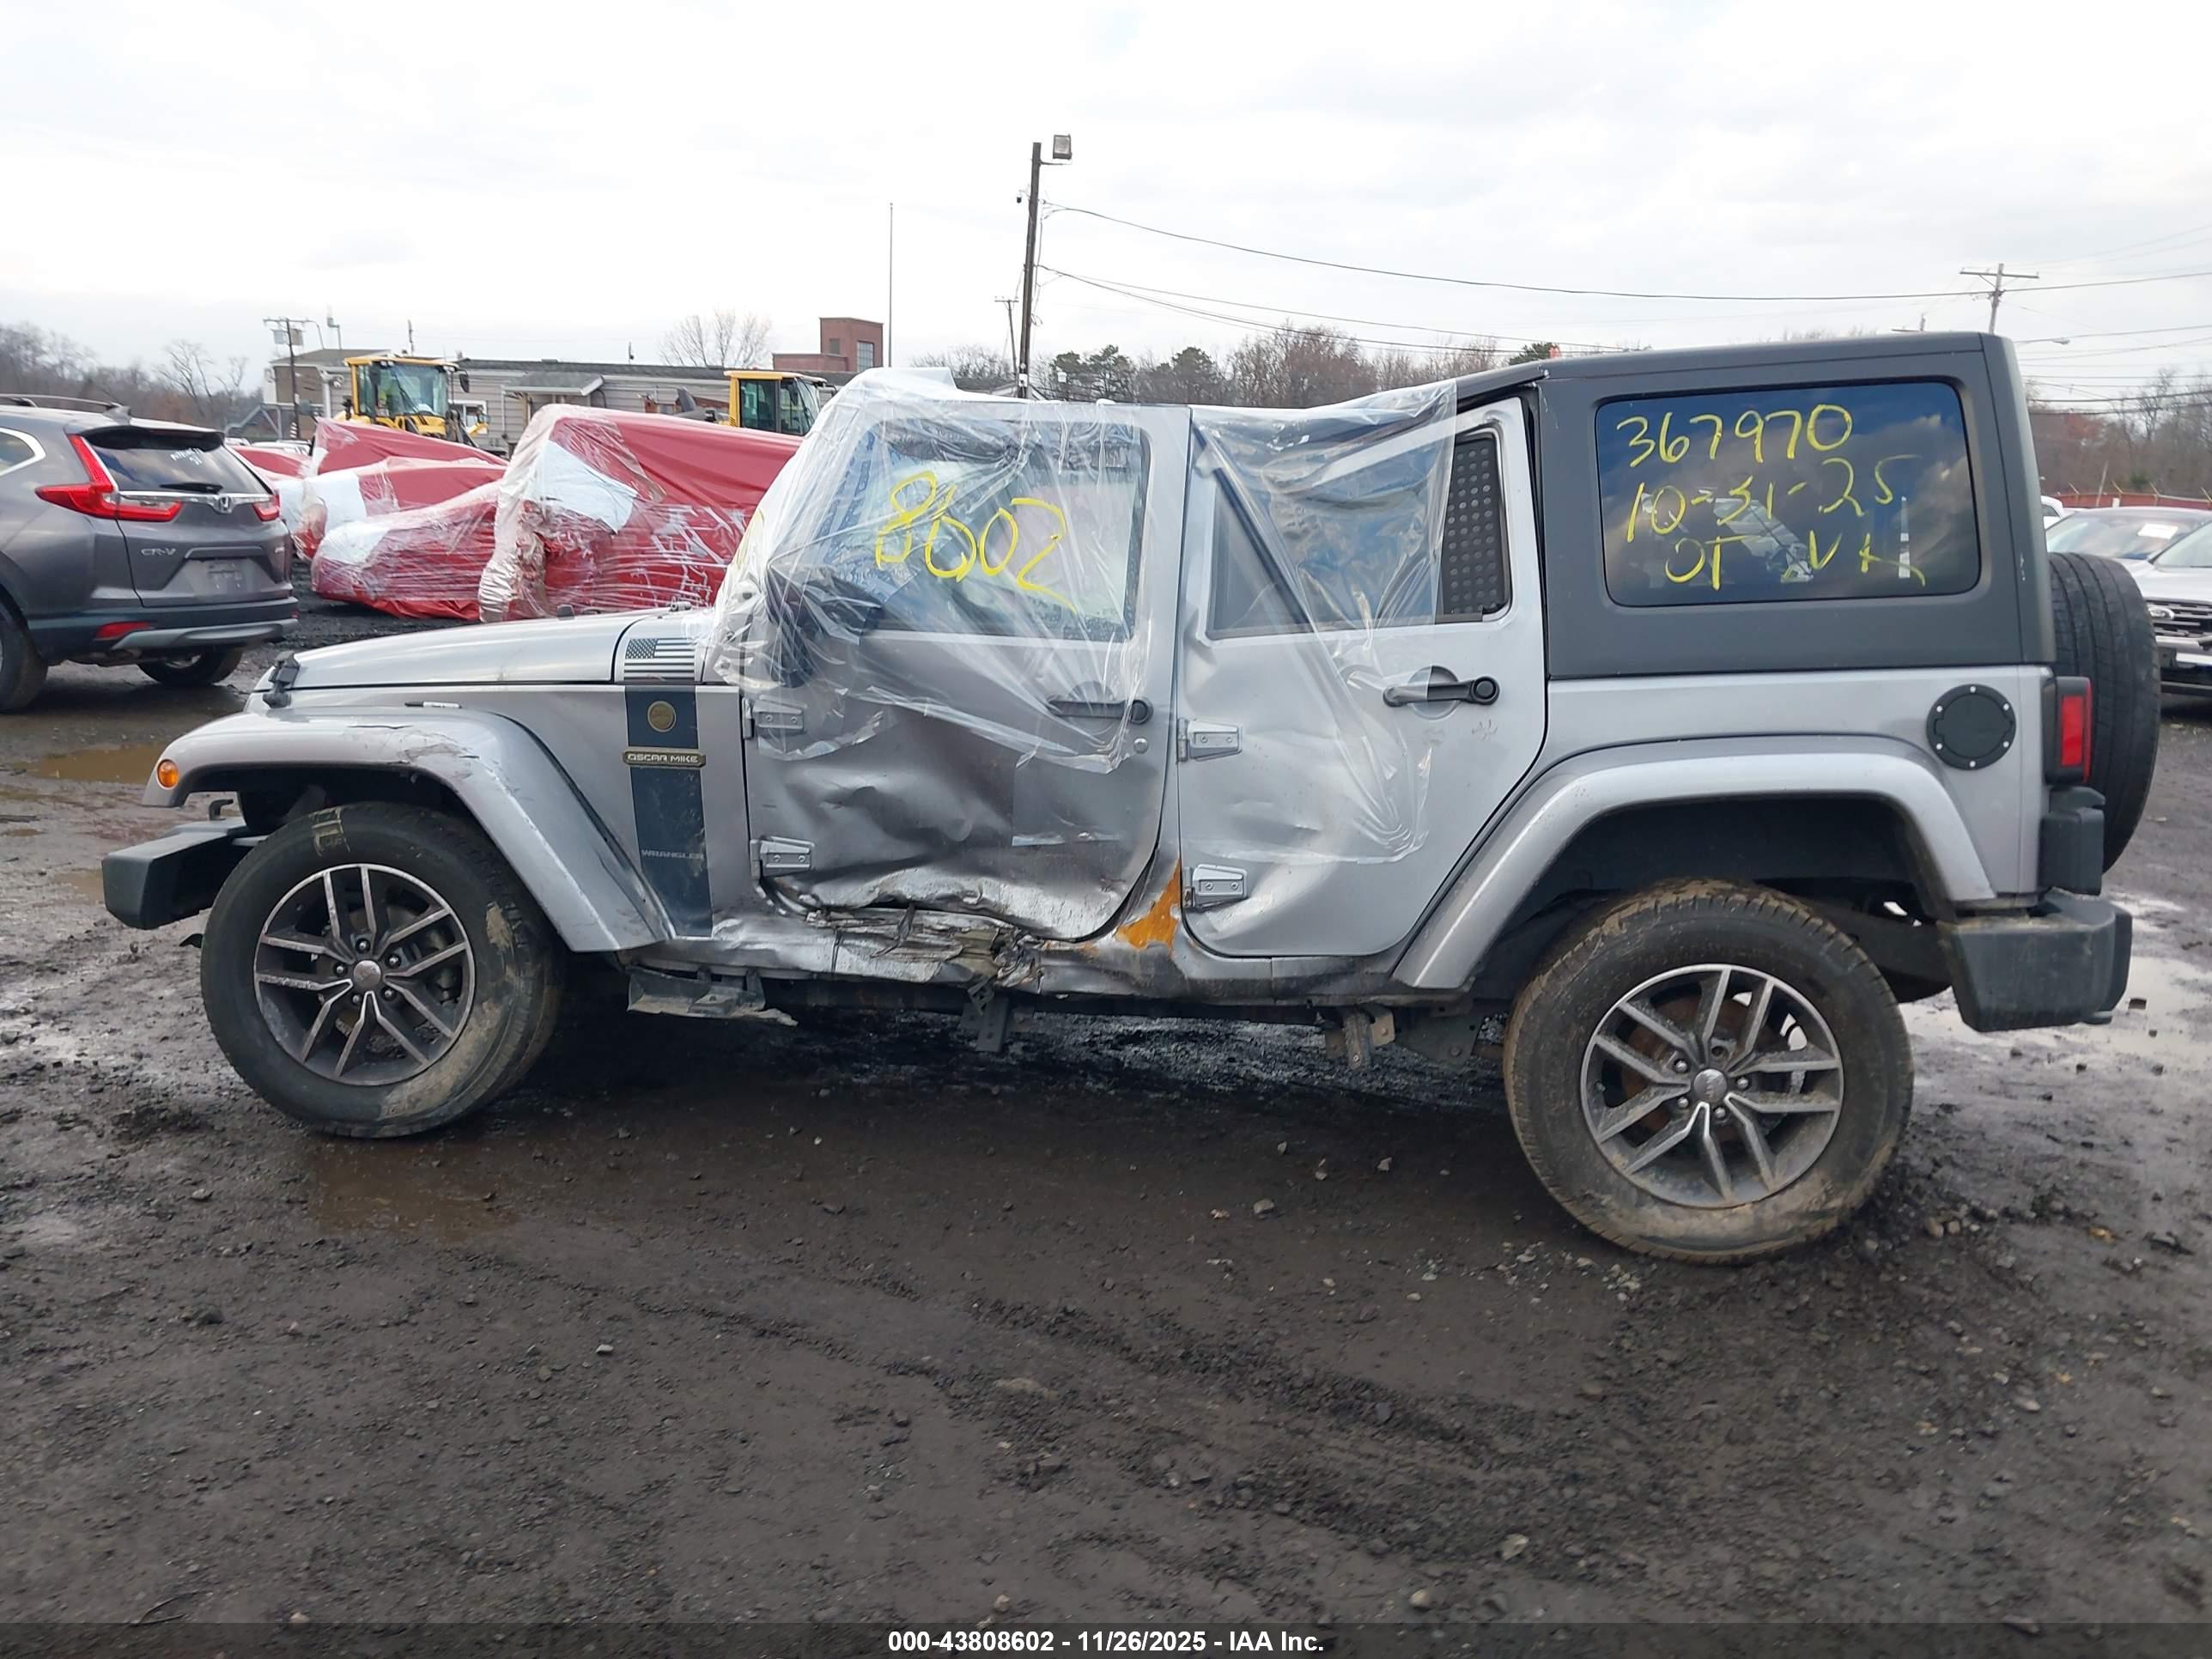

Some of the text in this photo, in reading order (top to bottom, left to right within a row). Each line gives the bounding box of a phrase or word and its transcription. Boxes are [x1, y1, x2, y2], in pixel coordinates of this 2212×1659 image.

[1617, 404, 1852, 467] 367970
[1626, 454, 1923, 544] 10-31-25
[140, 547, 177, 556] CR-V
[875, 470, 1078, 613] 8602
[627, 753, 699, 763] OSCAR MIKE
